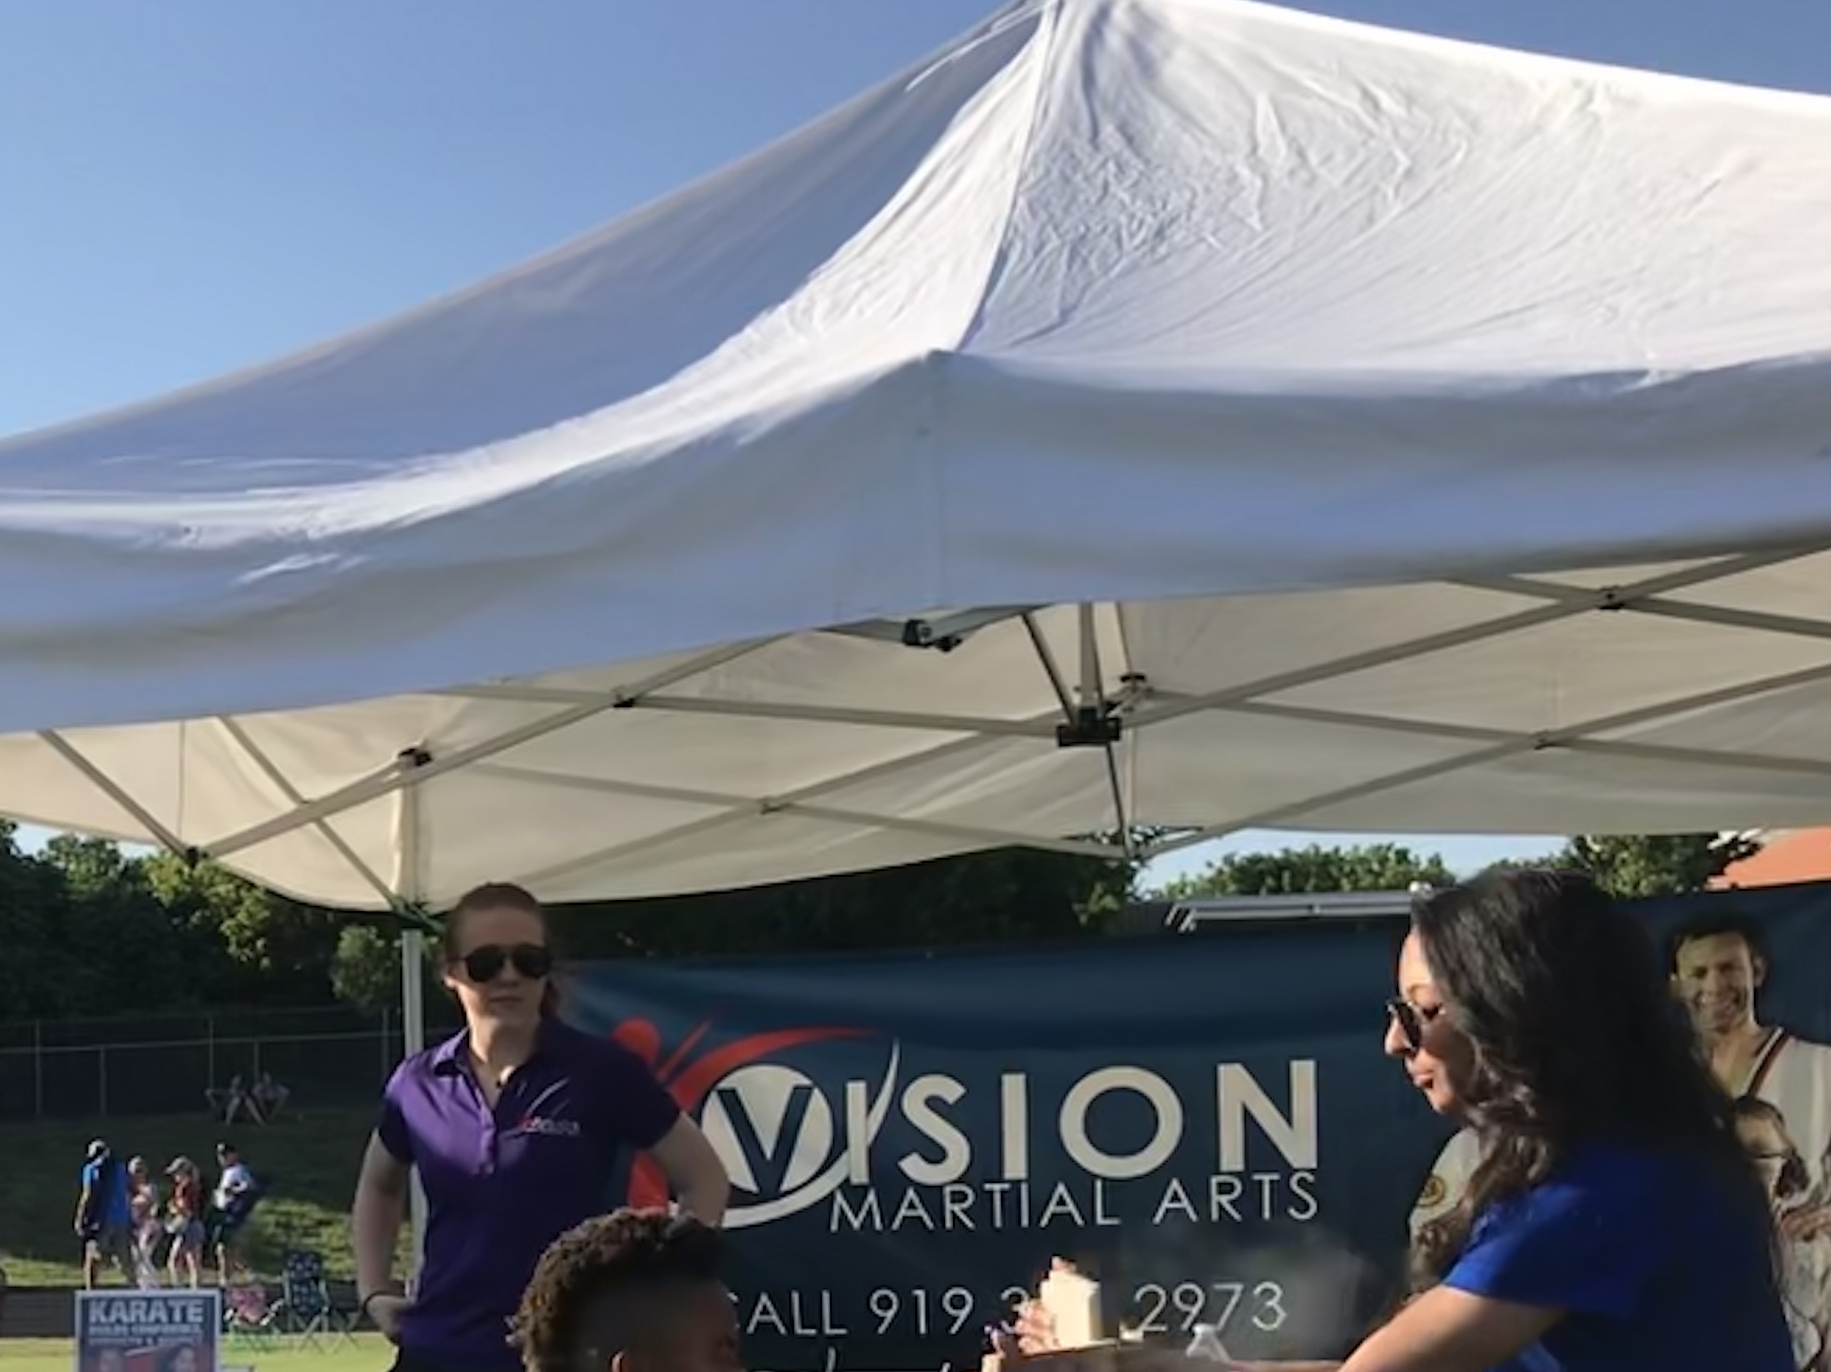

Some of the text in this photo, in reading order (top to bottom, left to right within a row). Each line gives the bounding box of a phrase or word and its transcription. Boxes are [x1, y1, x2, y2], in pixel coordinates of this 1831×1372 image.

[830, 1171, 1318, 1234] MARTIAL ARTS
[89, 1298, 204, 1323] KARATE
[727, 1289, 848, 1334] ALL
[869, 1286, 974, 1335] 919
[1134, 1281, 1287, 1333] 2973
